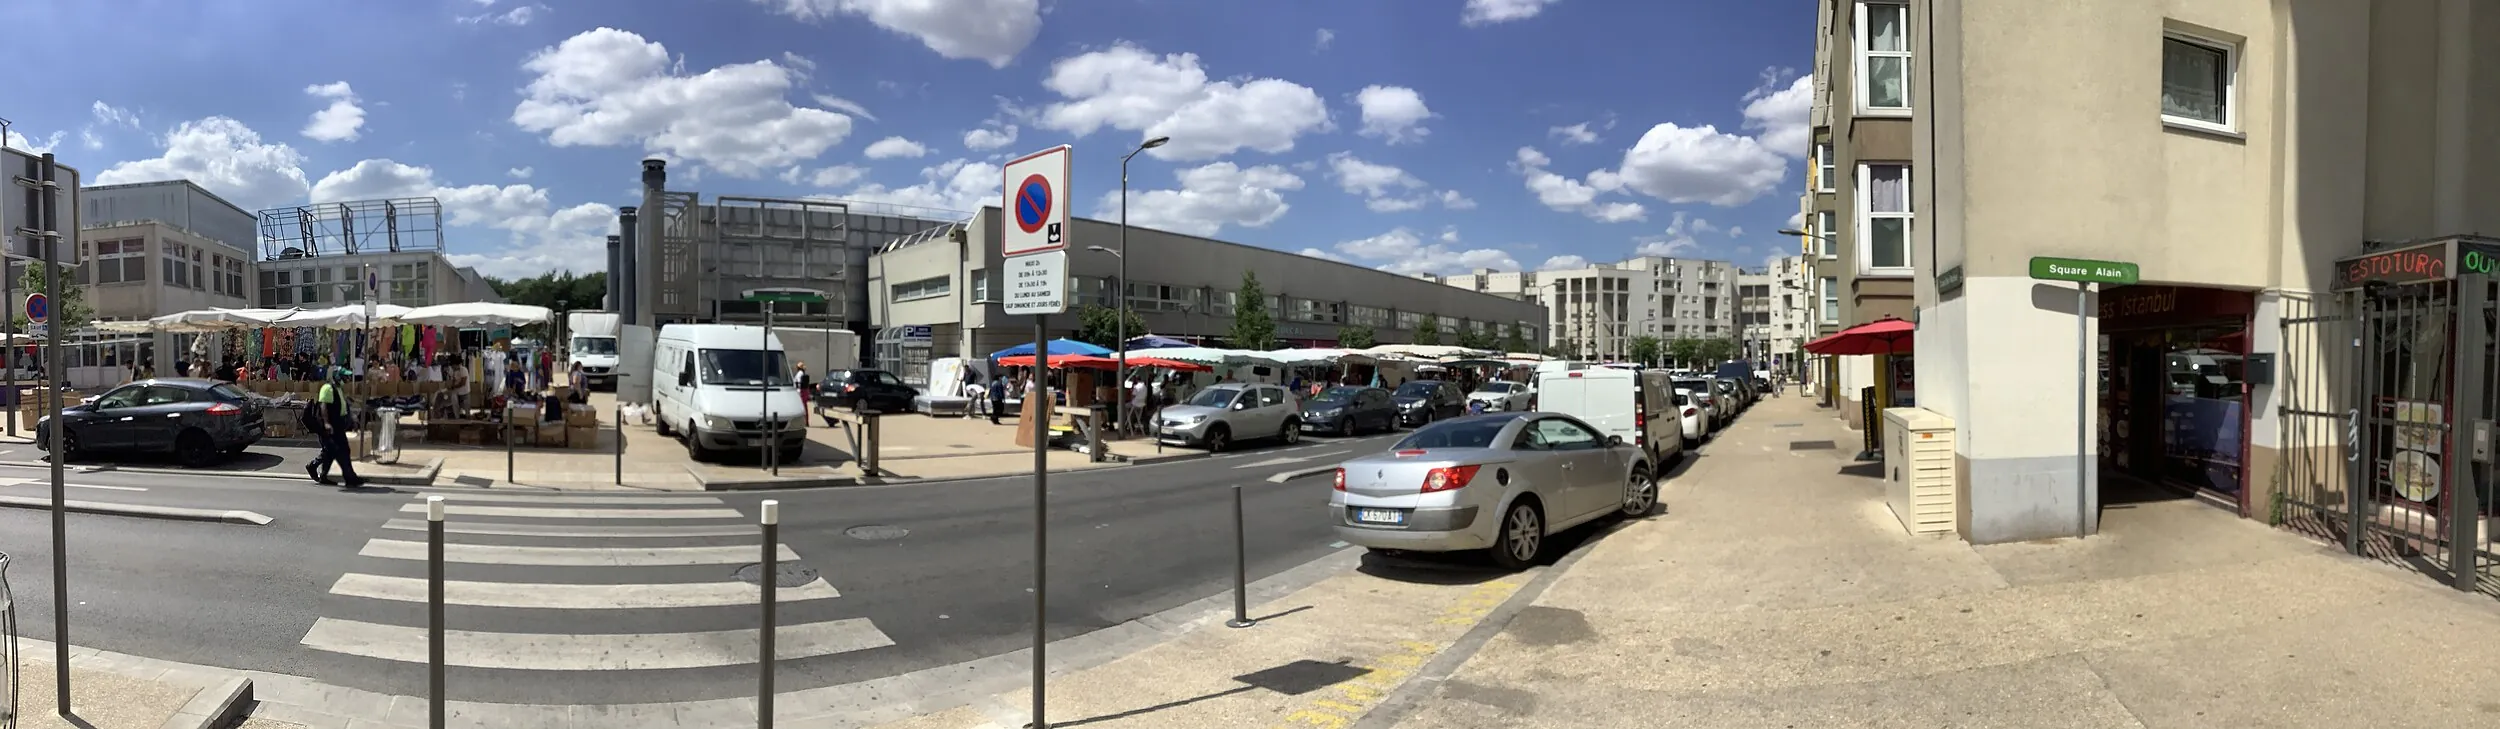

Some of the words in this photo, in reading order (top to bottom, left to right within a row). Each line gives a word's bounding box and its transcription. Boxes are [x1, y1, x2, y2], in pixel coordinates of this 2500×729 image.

[2049, 263, 2088, 277] Square
[2095, 267, 2122, 278] Alain
[2121, 286, 2177, 317] Istanbul
